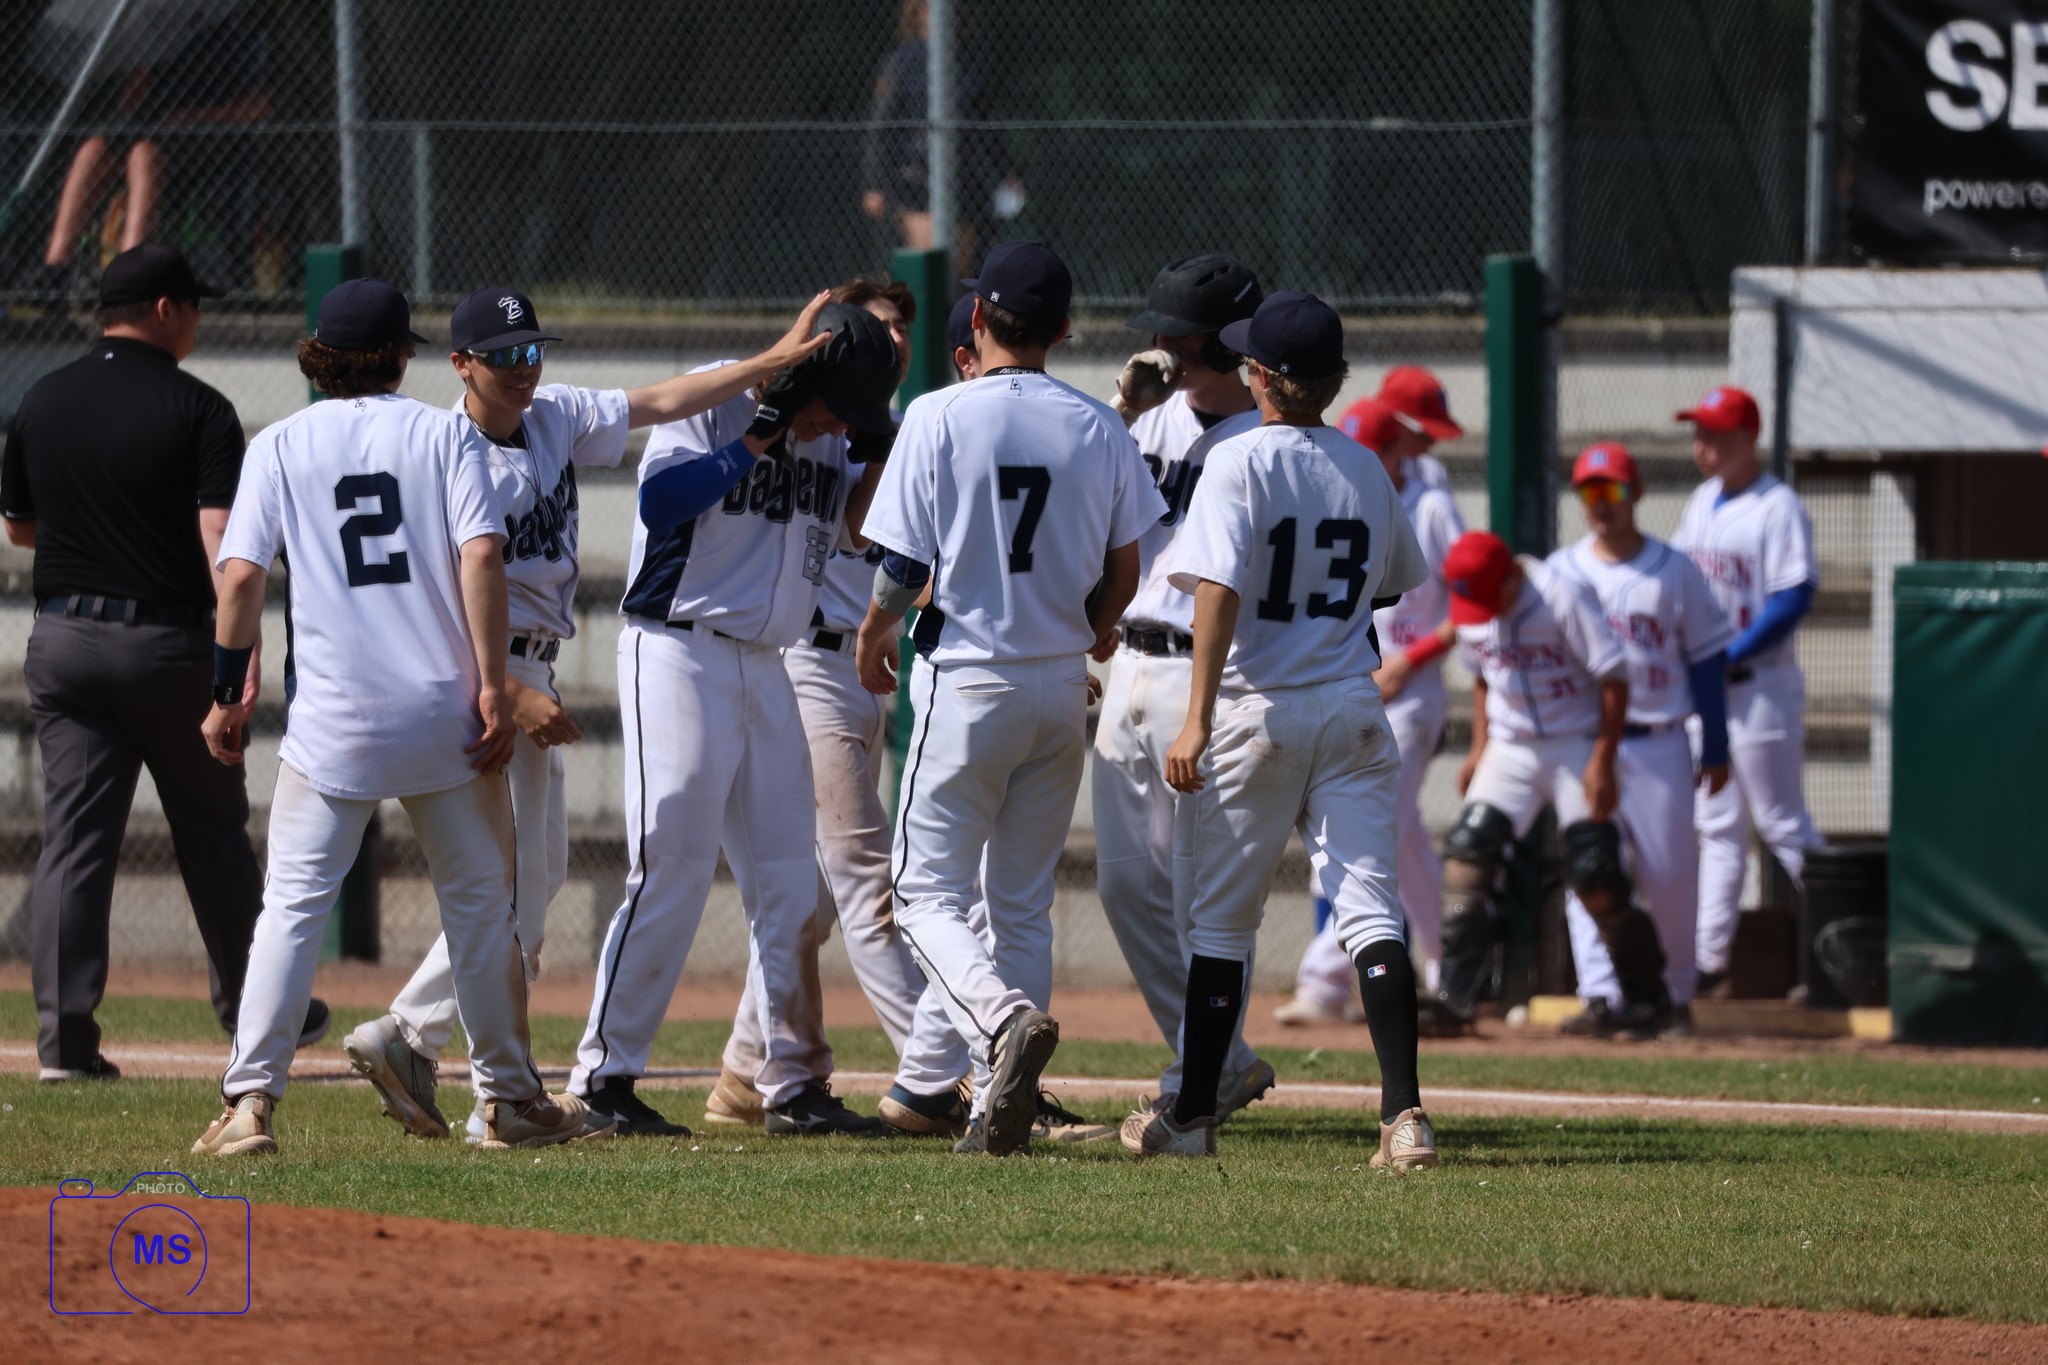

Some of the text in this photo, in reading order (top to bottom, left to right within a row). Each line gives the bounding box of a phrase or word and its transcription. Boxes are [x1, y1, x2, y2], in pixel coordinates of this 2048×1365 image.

[1925, 19, 2048, 131] SE
[1923, 179, 2048, 216] powere
[333, 471, 411, 588] 2
[998, 466, 1052, 573] 7
[1257, 517, 1371, 621] 13
